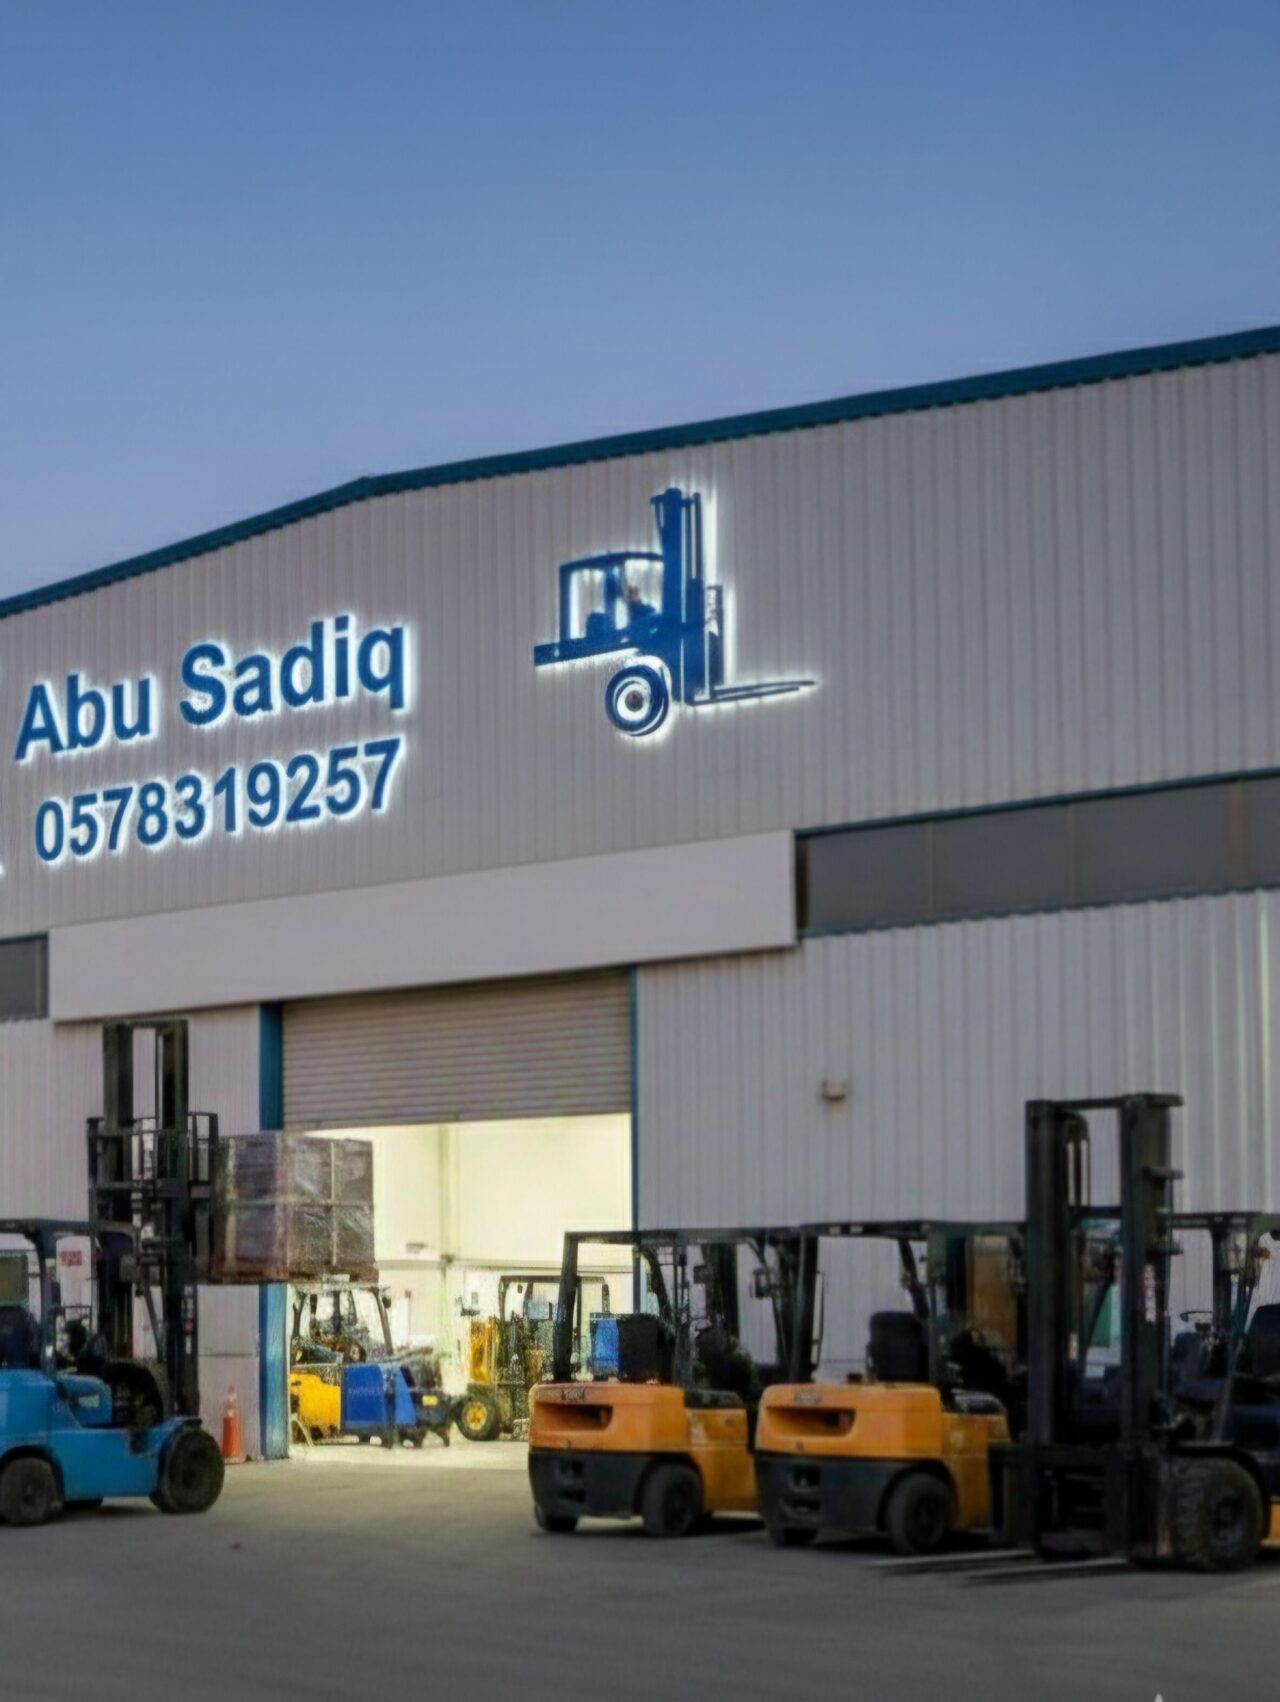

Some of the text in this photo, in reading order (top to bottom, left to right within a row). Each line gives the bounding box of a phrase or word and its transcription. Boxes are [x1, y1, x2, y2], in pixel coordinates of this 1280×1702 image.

[14, 615, 404, 760] Abu Sadiq
[34, 737, 402, 861] 0578319257
